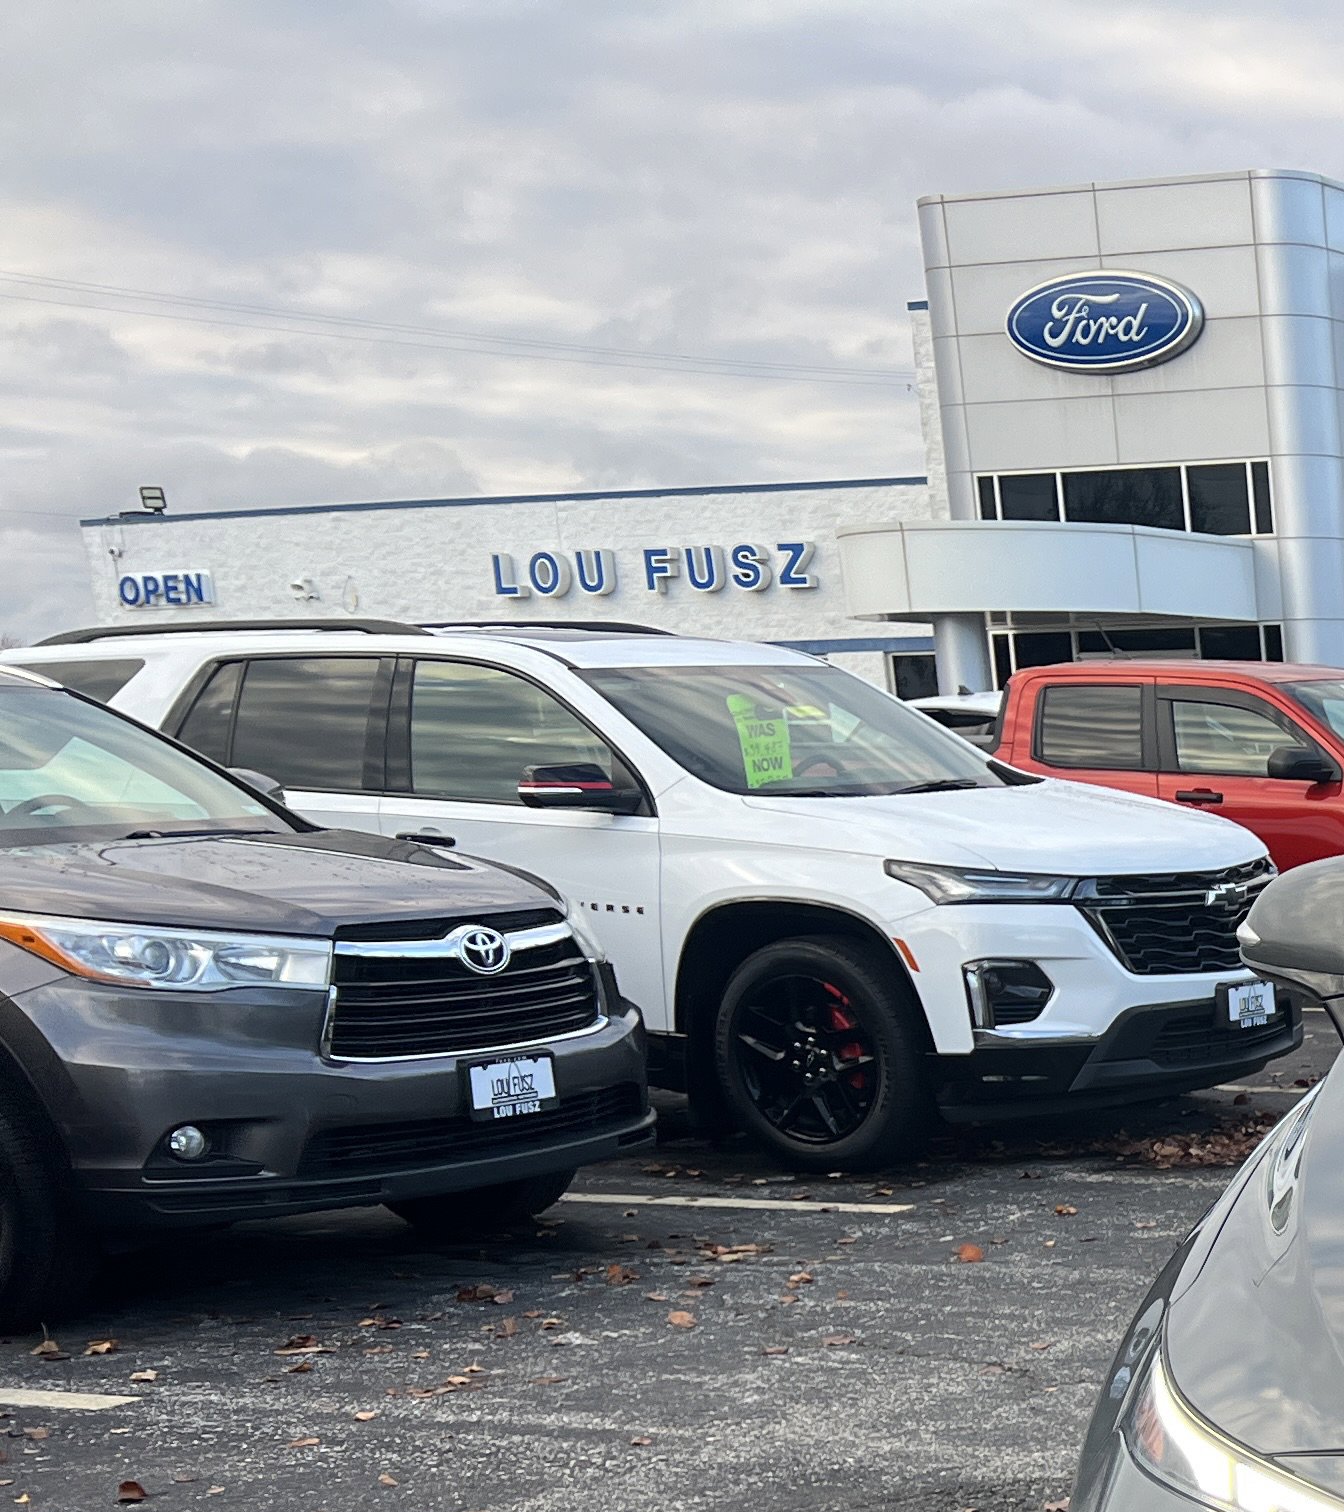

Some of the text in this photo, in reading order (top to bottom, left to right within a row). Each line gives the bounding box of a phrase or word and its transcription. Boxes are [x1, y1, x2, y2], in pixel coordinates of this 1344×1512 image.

[1043, 293, 1149, 348] Ford
[490, 541, 814, 598] LOU FUSZ
[119, 573, 205, 606] OPEN
[746, 722, 776, 739] WAS
[752, 756, 783, 773] NOW
[491, 1074, 535, 1096] LOU FUSZ
[494, 1101, 540, 1118] LOU FUSZ
